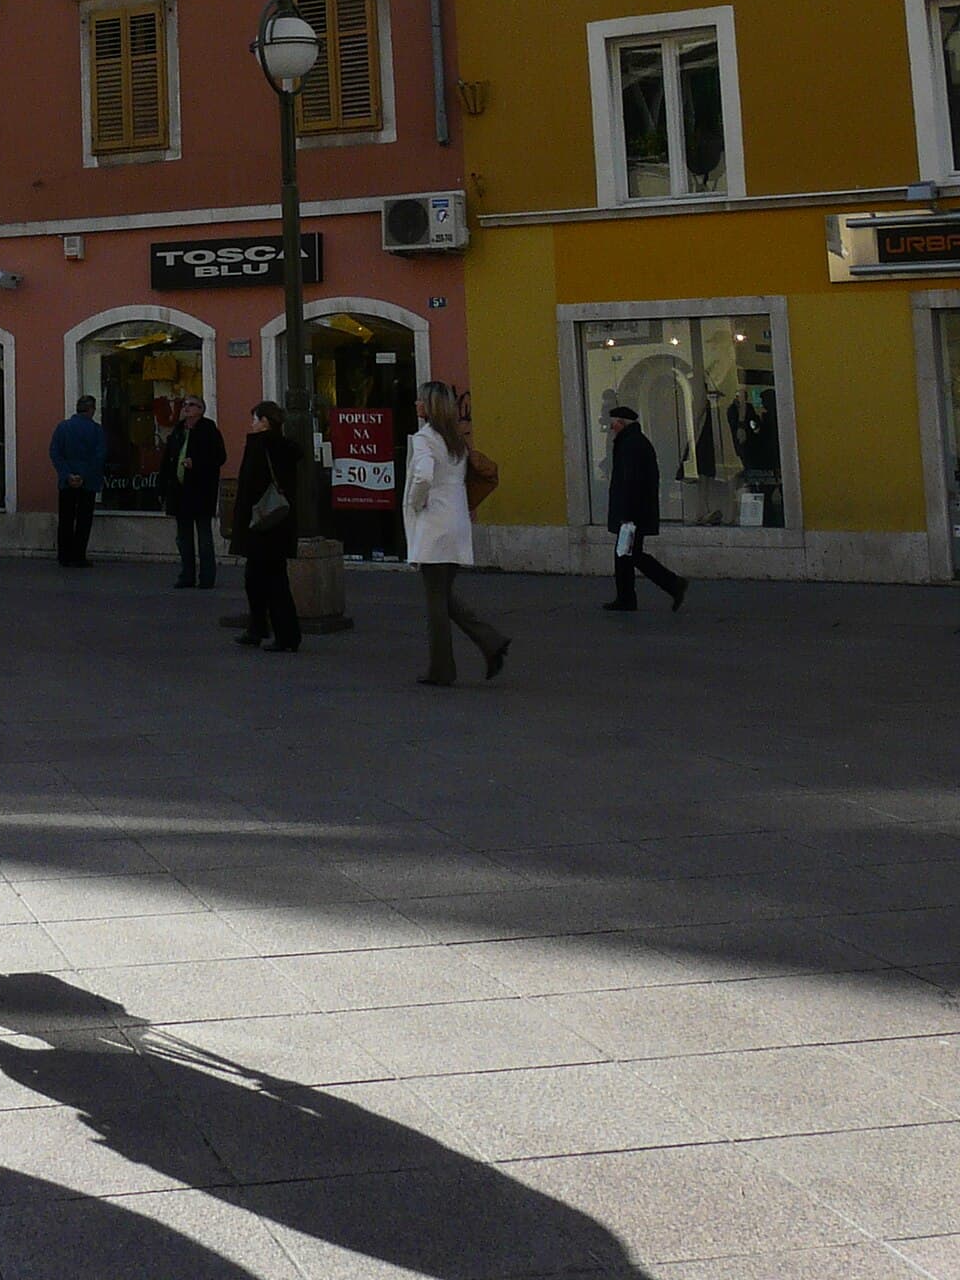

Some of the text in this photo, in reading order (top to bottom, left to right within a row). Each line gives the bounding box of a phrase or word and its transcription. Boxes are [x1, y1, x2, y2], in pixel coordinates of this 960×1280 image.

[194, 262, 269, 278] BLU
[338, 413, 384, 424] POPUST
[353, 428, 370, 440] NA
[349, 443, 377, 455] KASI
